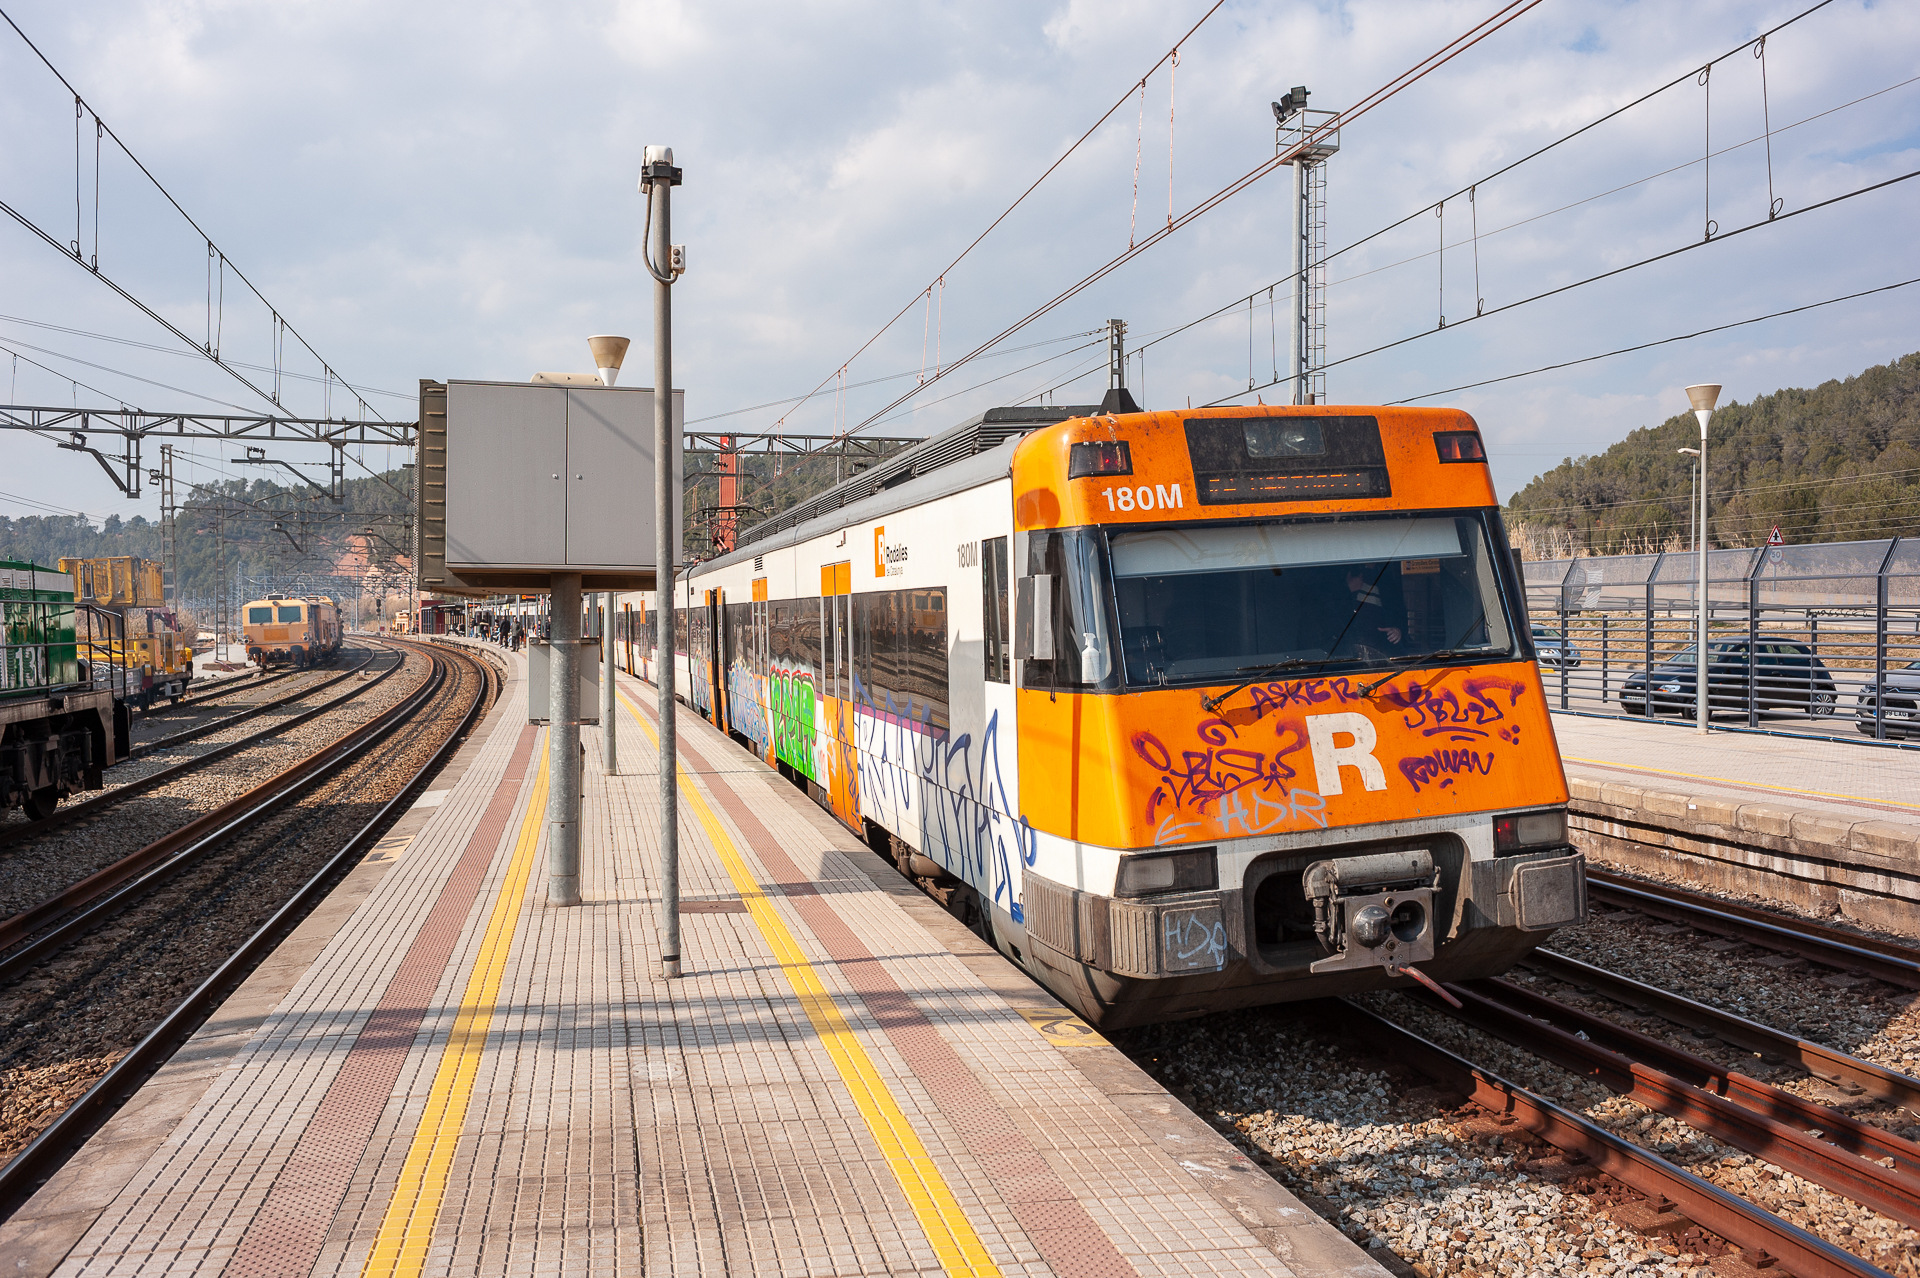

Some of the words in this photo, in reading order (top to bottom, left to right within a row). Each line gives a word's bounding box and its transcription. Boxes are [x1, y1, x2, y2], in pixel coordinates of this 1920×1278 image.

[1101, 483, 1183, 512] 180M
[957, 541, 978, 568] 180M
[1250, 677, 1359, 719] ASKER
[1305, 711, 1387, 796] R
